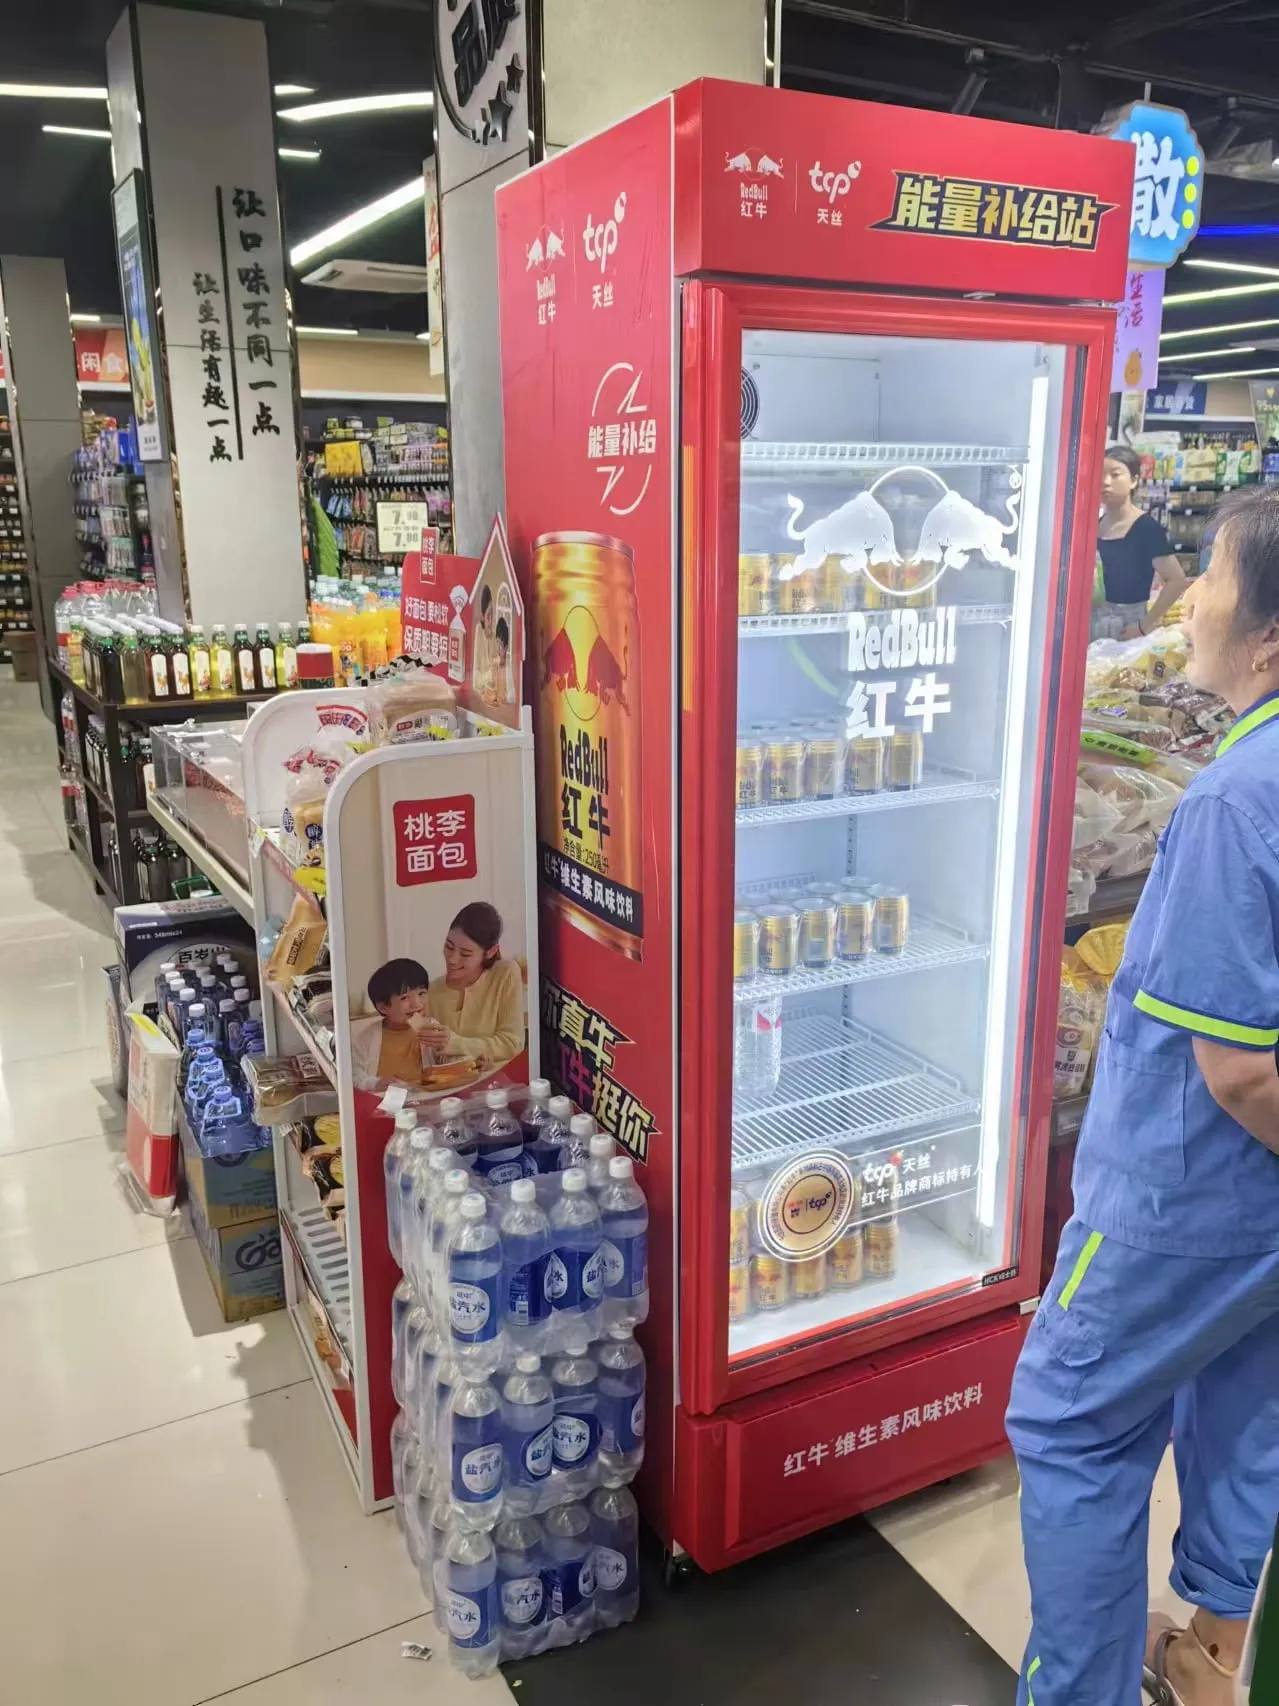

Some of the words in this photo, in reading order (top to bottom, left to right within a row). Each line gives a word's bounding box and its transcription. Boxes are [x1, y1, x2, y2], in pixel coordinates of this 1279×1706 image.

[740, 181, 769, 201] RedBull
[809, 161, 850, 203] tcp
[741, 202, 768, 219] 红牛
[816, 208, 843, 227] 天丝
[895, 176, 1097, 246] 能量补给站
[583, 211, 618, 274] tcp
[232, 187, 281, 436] 让口味不同一点
[538, 302, 557, 326] 红牛
[592, 282, 614, 309] 天丝
[192, 272, 232, 462] 让生活有趣一点
[588, 419, 657, 459] 能量补给
[848, 605, 957, 673] RedBull
[846, 672, 952, 741] 红牛
[560, 723, 609, 795] RedBull
[404, 809, 467, 842] 桃李
[562, 781, 611, 849] 红牛
[405, 842, 468, 874] 面包
[861, 1158, 984, 1208] 红牛品牌商标持有人
[862, 1162, 895, 1186] tcp
[902, 1152, 932, 1175] 天丝
[809, 1197, 828, 1211] tcp
